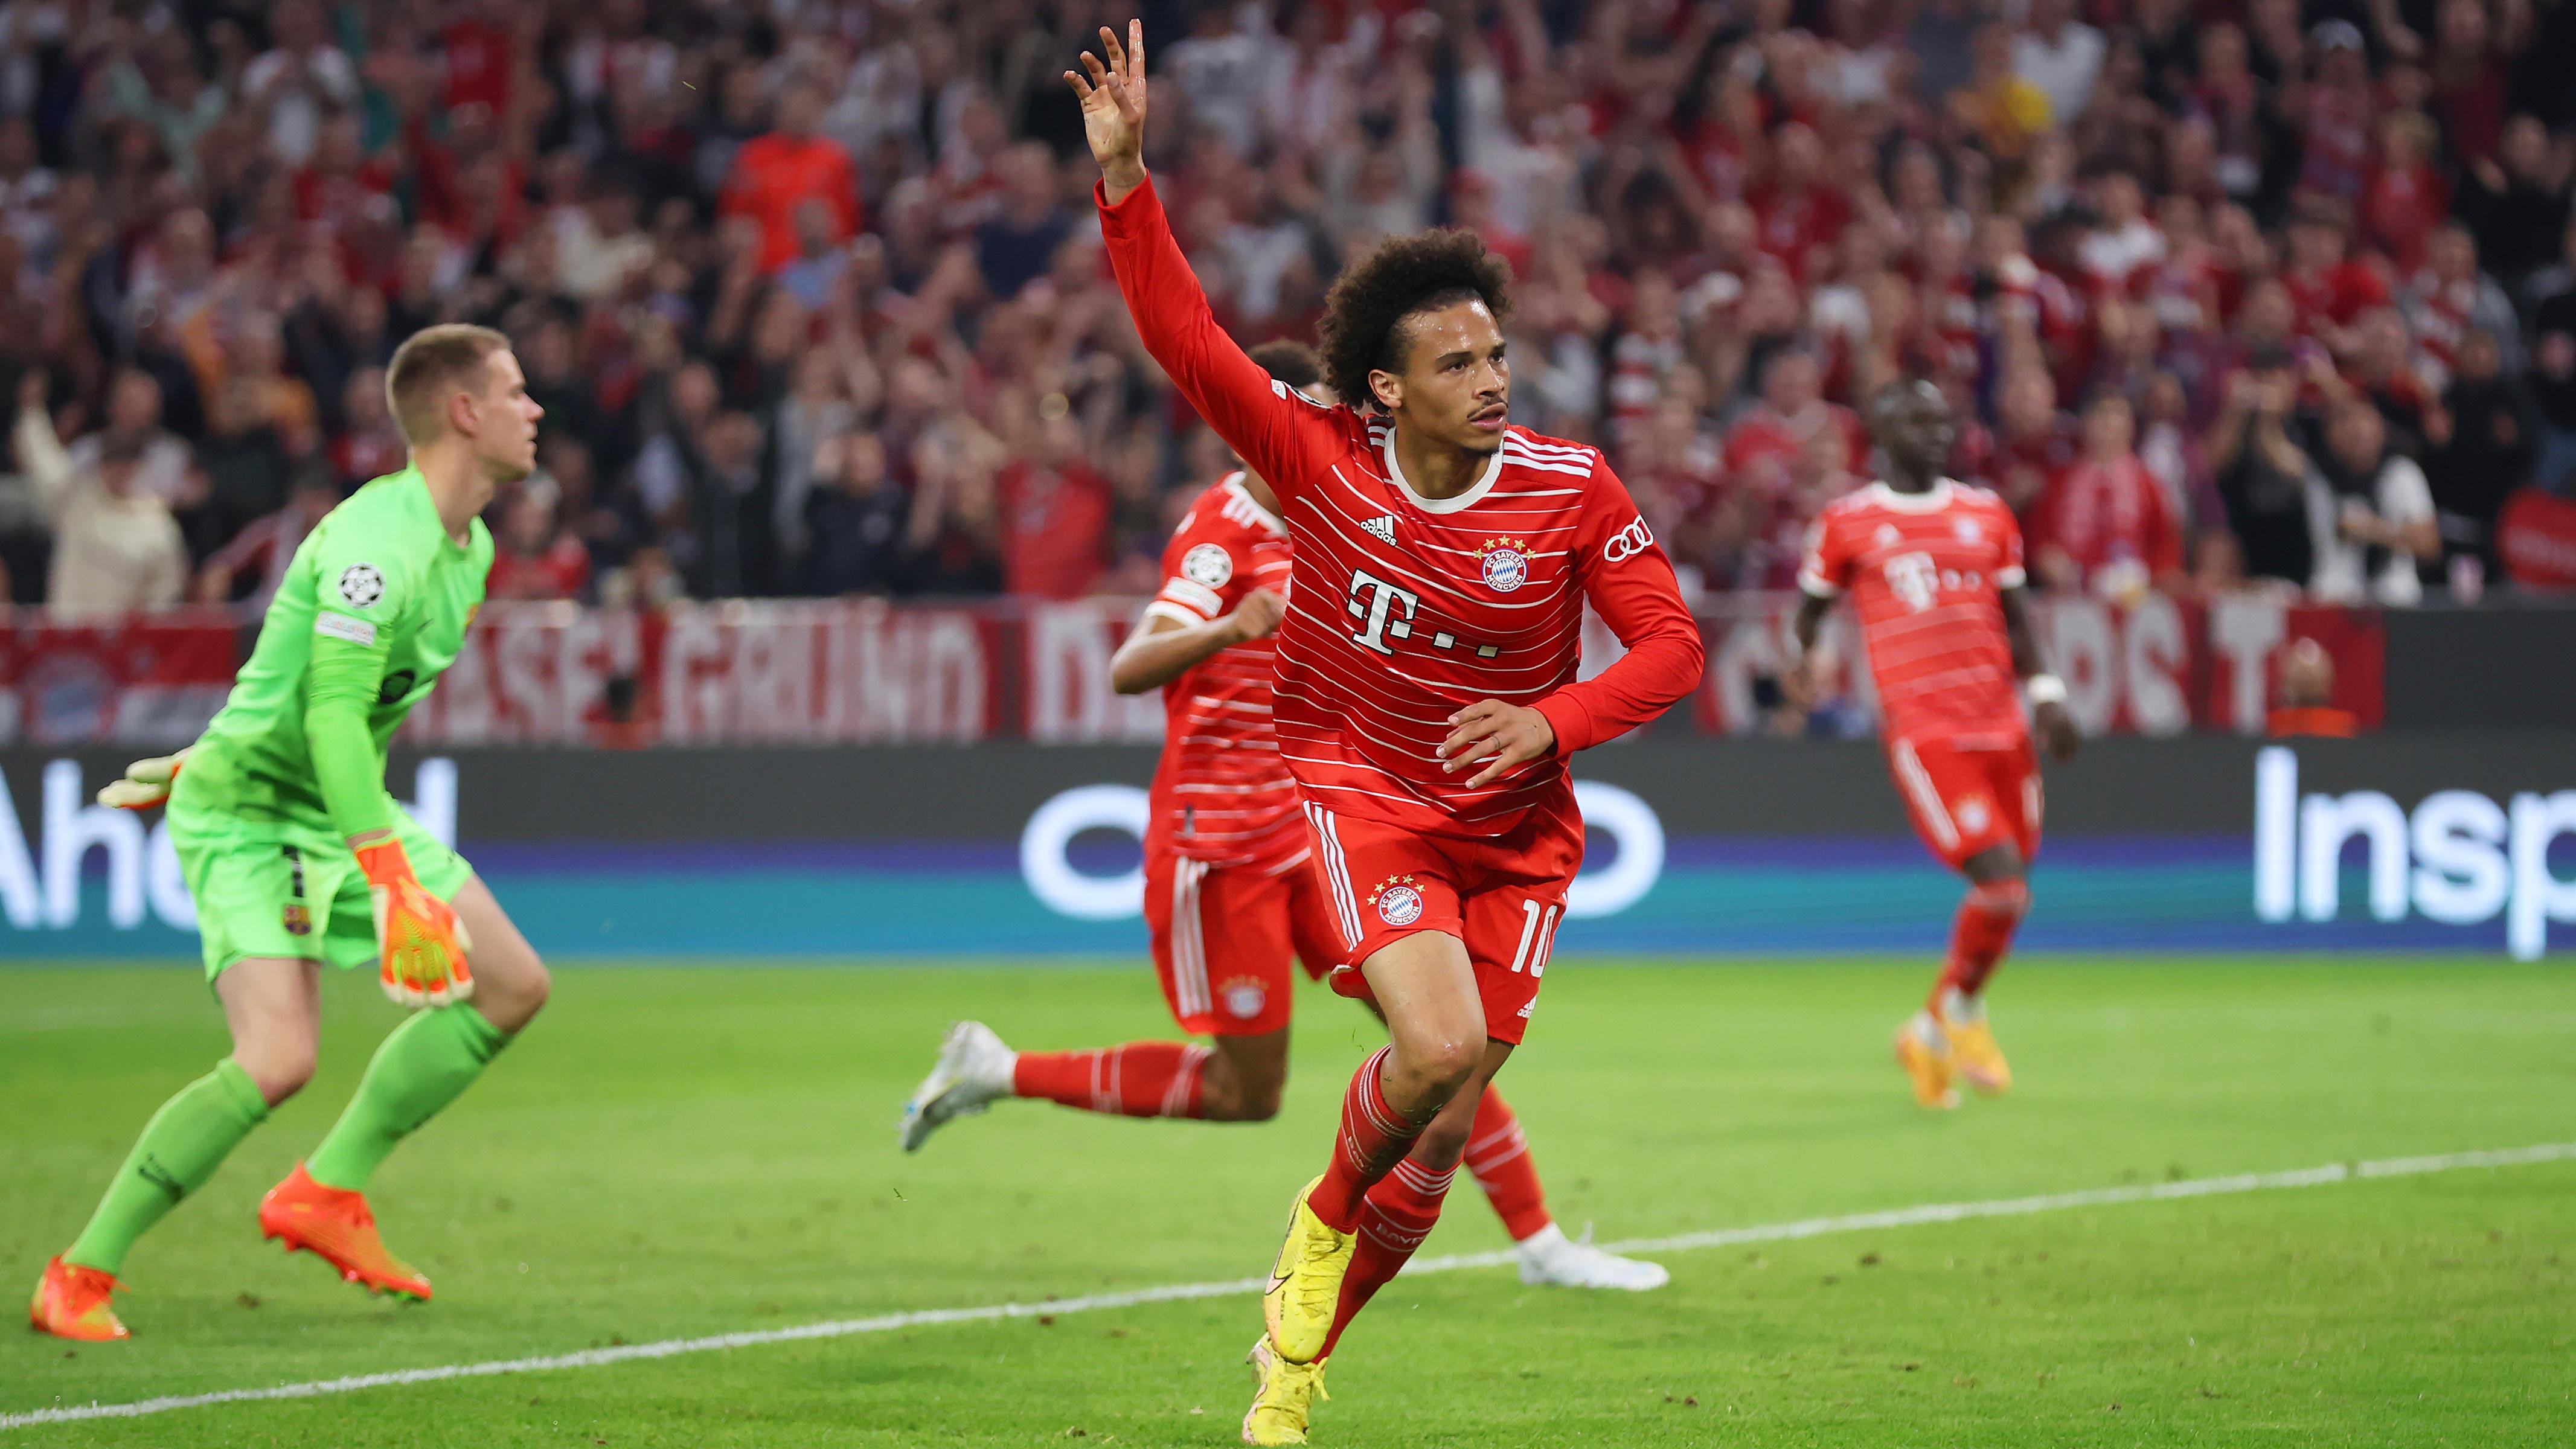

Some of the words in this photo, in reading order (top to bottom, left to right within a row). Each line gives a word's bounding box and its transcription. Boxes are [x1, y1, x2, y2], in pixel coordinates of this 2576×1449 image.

[1360, 520, 1397, 546] adidas
[1486, 557, 1496, 569] FC
[1495, 552, 1523, 569] BAYERN
[2254, 745, 2576, 962] Insp
[1387, 889, 1417, 901] BAYERN
[1511, 899, 1558, 978] 10
